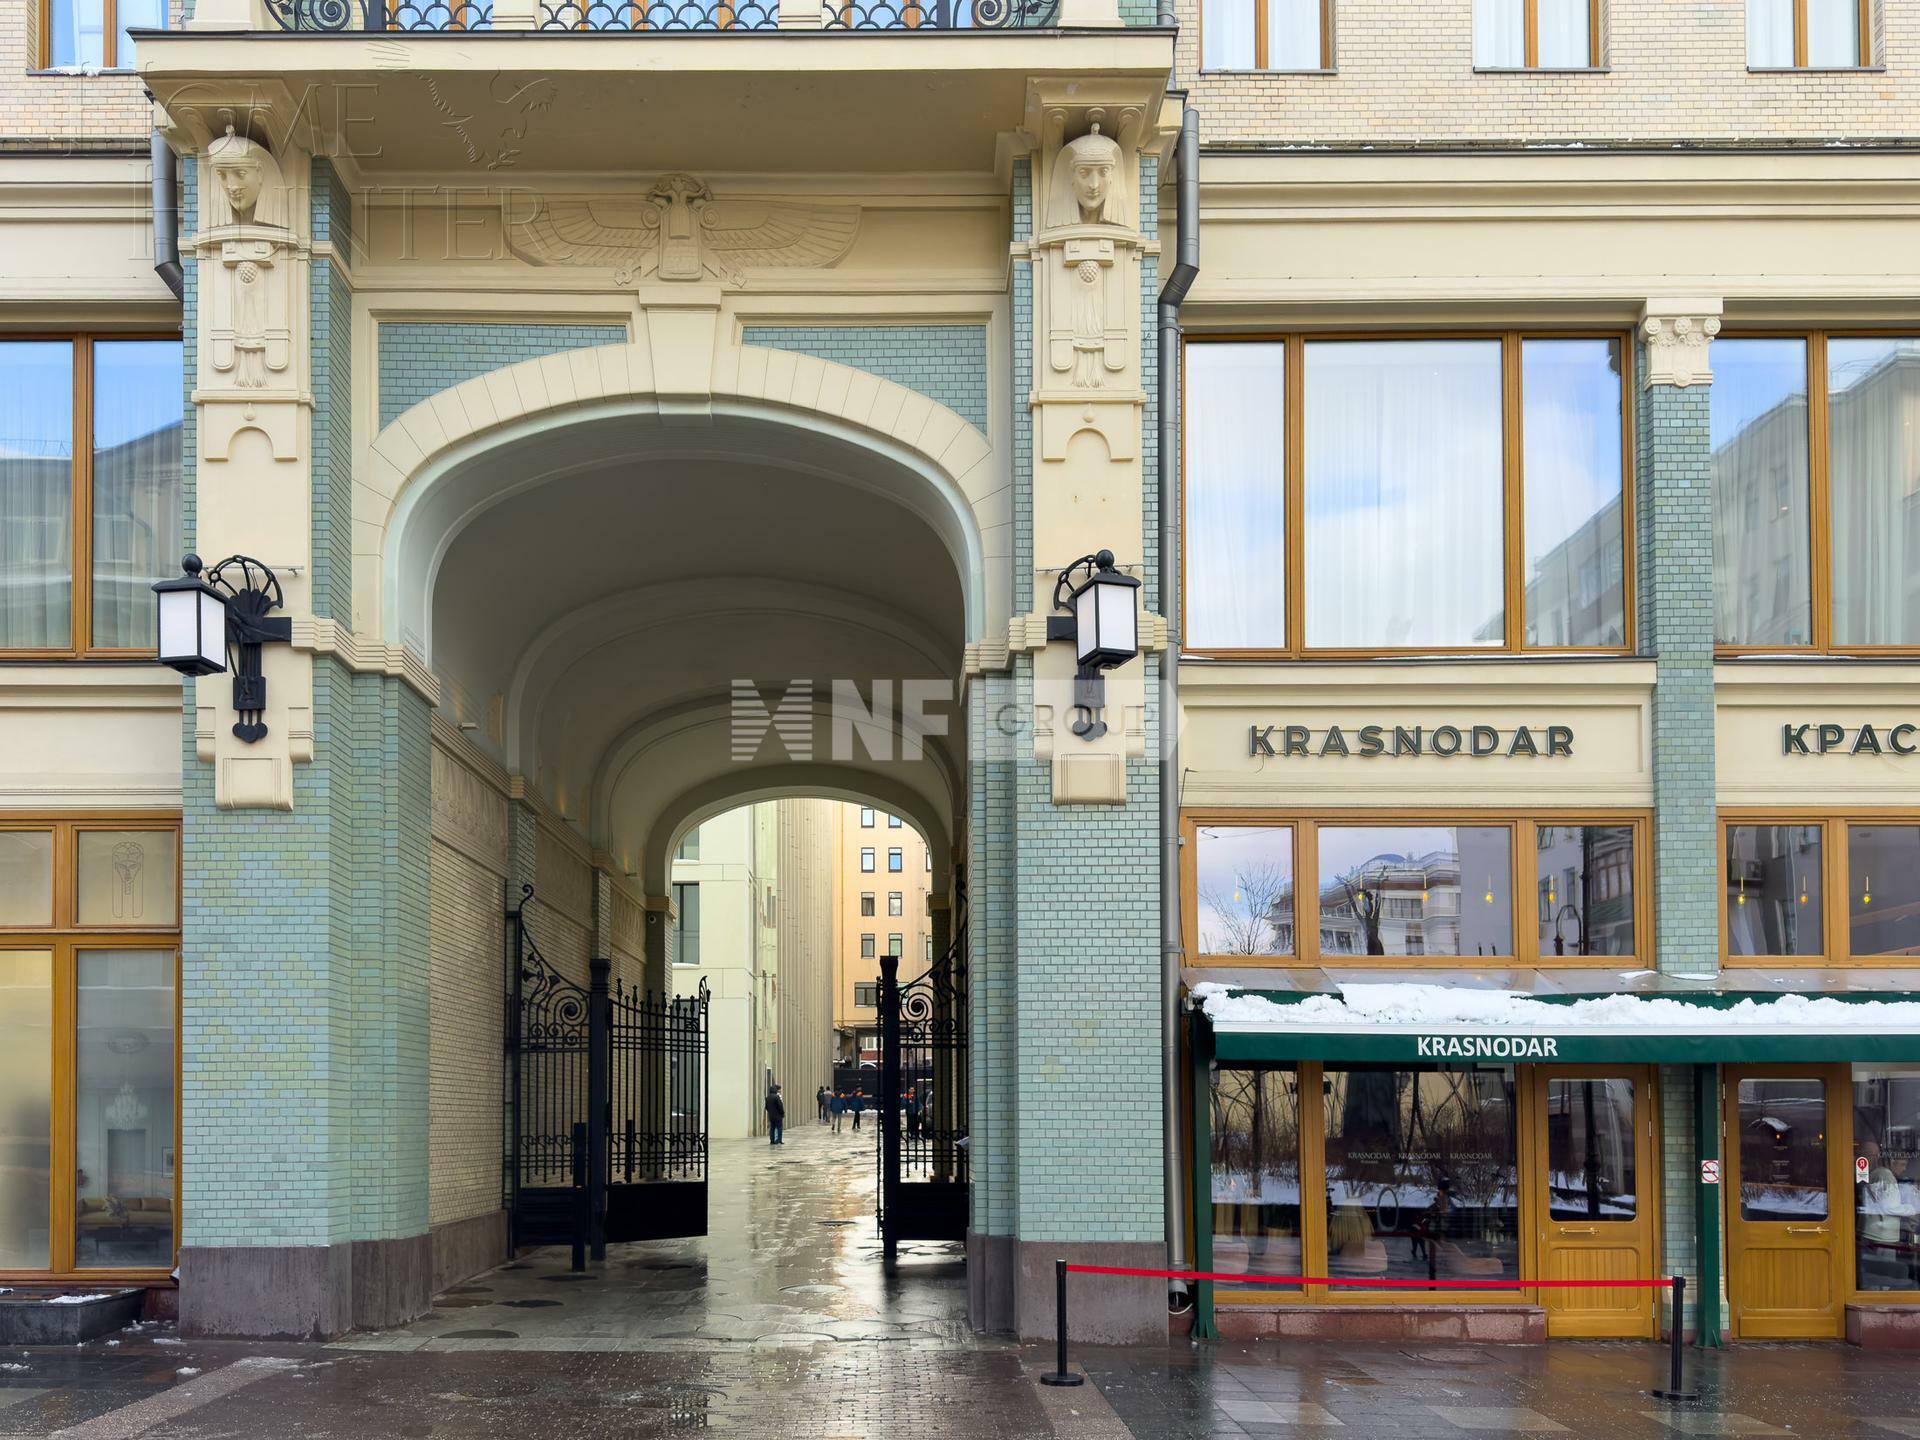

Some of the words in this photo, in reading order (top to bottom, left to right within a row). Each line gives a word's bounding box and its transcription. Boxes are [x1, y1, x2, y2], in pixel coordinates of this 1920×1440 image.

[1248, 724, 1575, 757] KRASNODAR
[1782, 723, 1918, 755] КРАС
[1417, 1036, 1558, 1057] KRASNODAR
[1347, 1151, 1391, 1160] KRASNODAR
[1398, 1151, 1441, 1160] KRASNODAR
[1449, 1151, 1493, 1160] KRASNODAR
